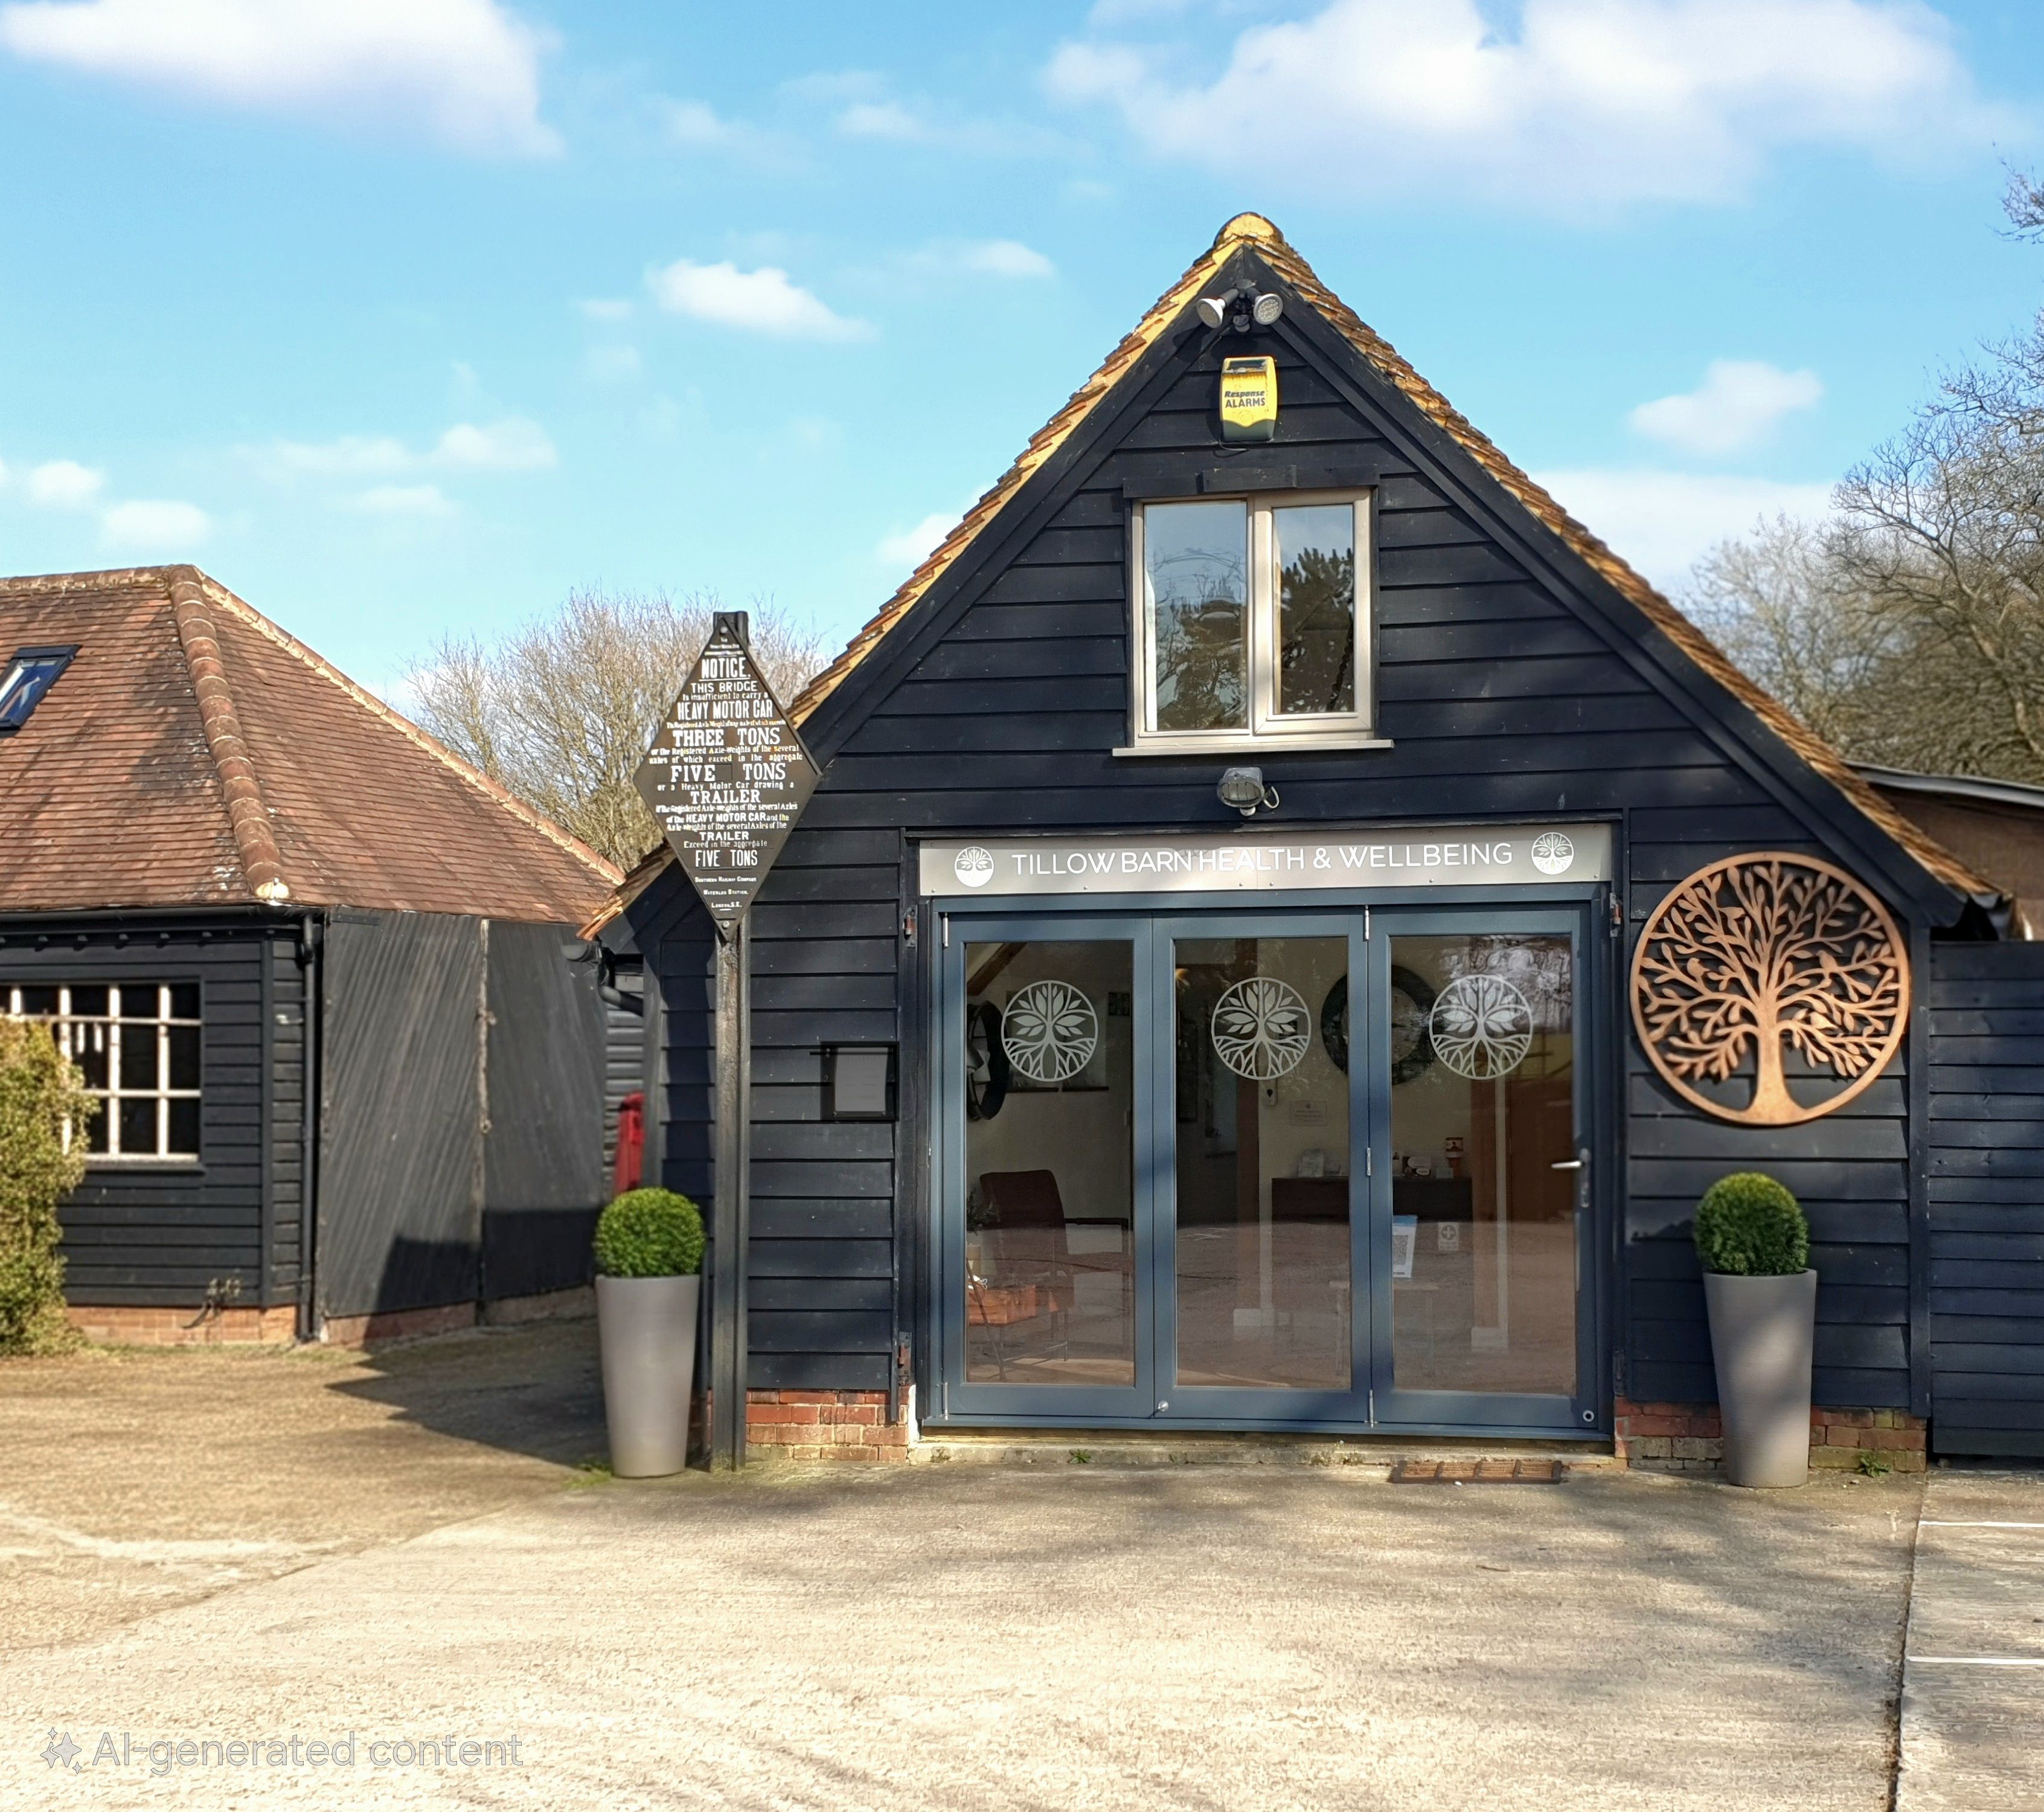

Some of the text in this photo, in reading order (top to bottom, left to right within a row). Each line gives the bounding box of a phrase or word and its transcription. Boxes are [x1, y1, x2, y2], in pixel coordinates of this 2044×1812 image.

[1225, 397, 1266, 408] ALARMS
[702, 657, 751, 679] NOTICE.
[691, 681, 758, 693] THIS BRIDGE
[677, 699, 773, 721] HEAVY MOTOR CAR
[673, 727, 780, 747] THREE TONS
[671, 747, 706, 756] Registered
[769, 753, 803, 762] aggregate
[671, 763, 786, 782] FIVE TONS
[754, 781, 783, 790] drawing
[690, 789, 761, 804] TRAILER
[686, 814, 713, 823] HEAVY
[716, 812, 746, 822] MOTOR
[749, 812, 766, 821] CAR
[700, 831, 749, 840] TRAILER
[733, 840, 767, 849] aggregate
[696, 849, 758, 867] FIVE TONS
[1011, 843, 1512, 875] TILLOW BARN HEALTH & WELLBEING
